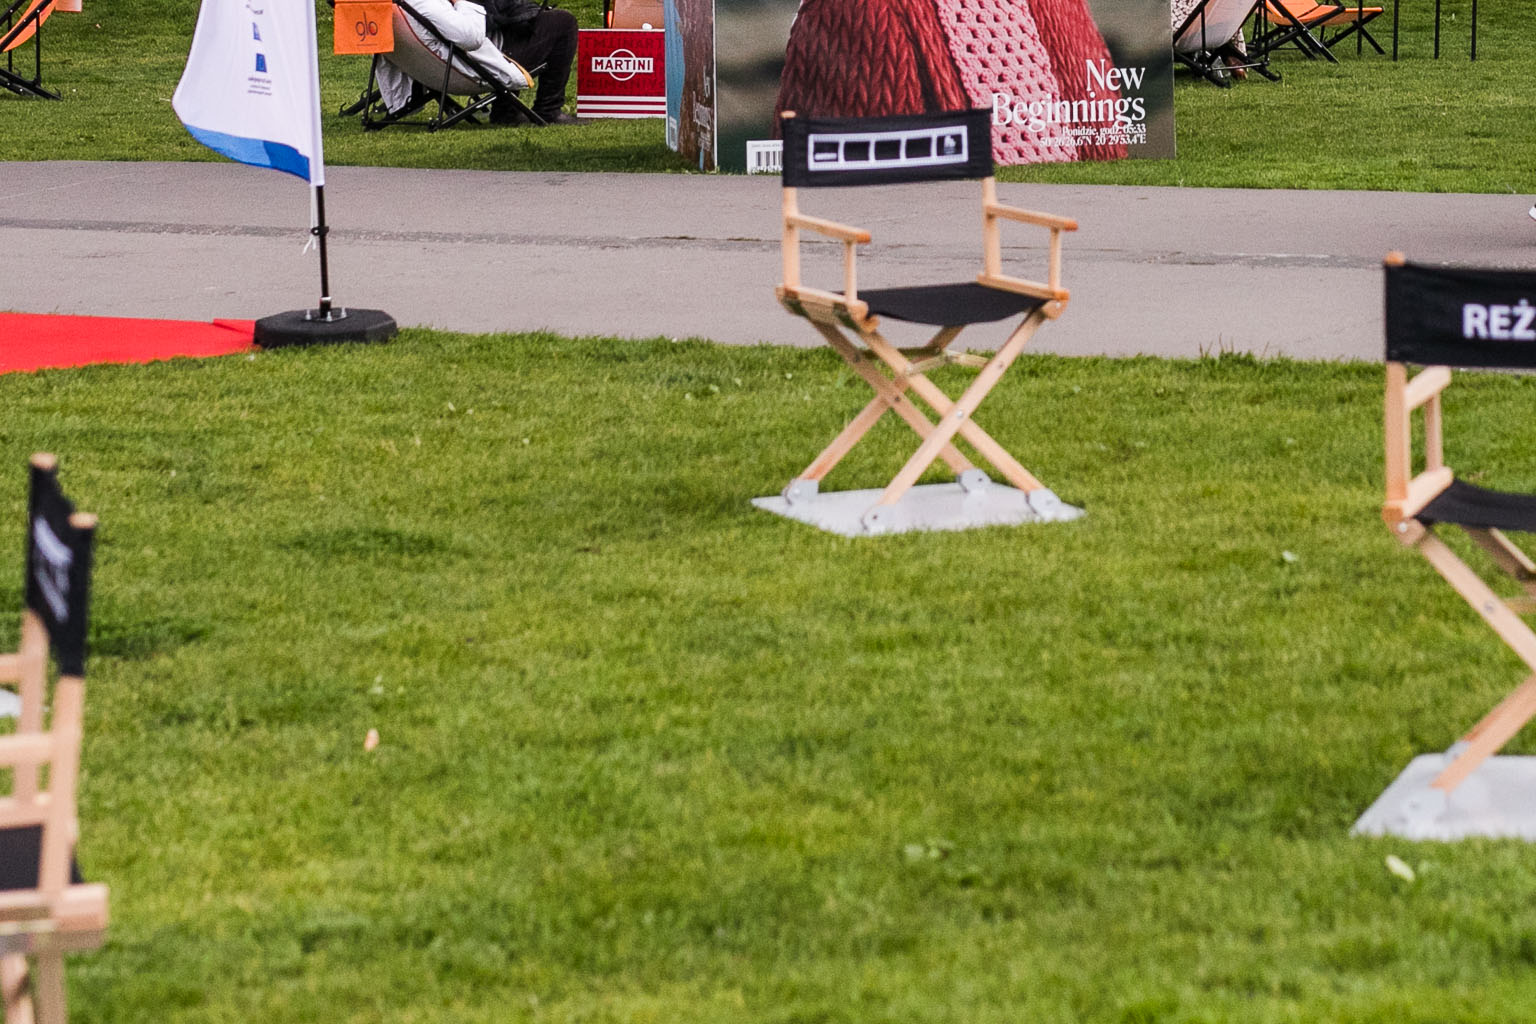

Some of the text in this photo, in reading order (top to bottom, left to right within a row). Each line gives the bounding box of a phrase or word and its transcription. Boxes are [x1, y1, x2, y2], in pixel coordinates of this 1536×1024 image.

[355, 10, 379, 42] glo
[594, 58, 651, 71] MARTINI
[1086, 58, 1146, 92] New
[991, 91, 1146, 133] Beginnings
